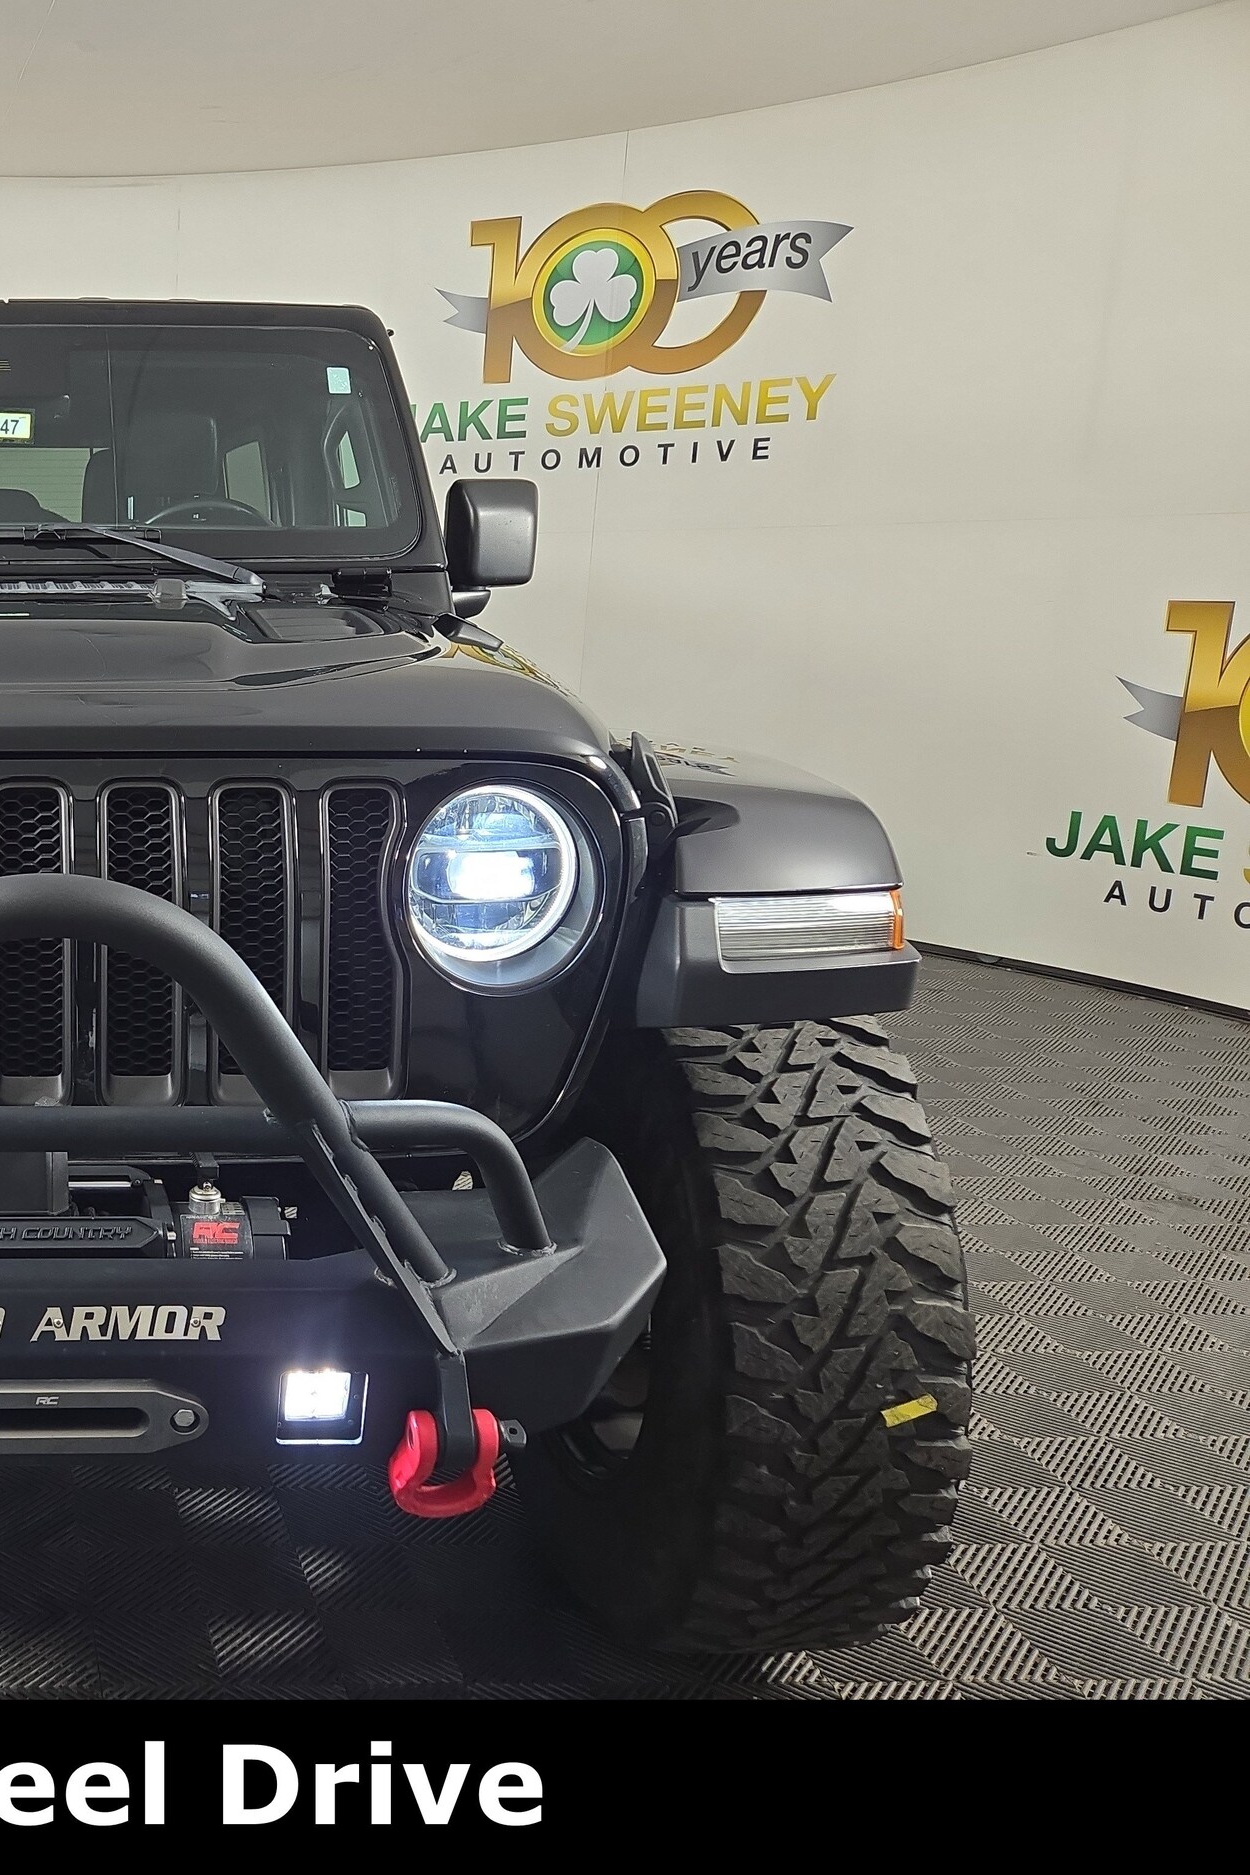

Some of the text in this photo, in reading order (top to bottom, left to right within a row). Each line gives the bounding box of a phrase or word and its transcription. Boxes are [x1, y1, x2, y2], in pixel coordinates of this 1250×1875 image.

[687, 230, 812, 292] years
[471, 189, 767, 384] 100
[410, 373, 836, 443] AKE SWEENEY
[439, 437, 771, 475] AUTOMOTIVE
[1046, 810, 1225, 881] JAKE
[21, 1226, 133, 1241] COUNTRY
[30, 1305, 227, 1343] ARMOR
[35, 1396, 60, 1405] RC
